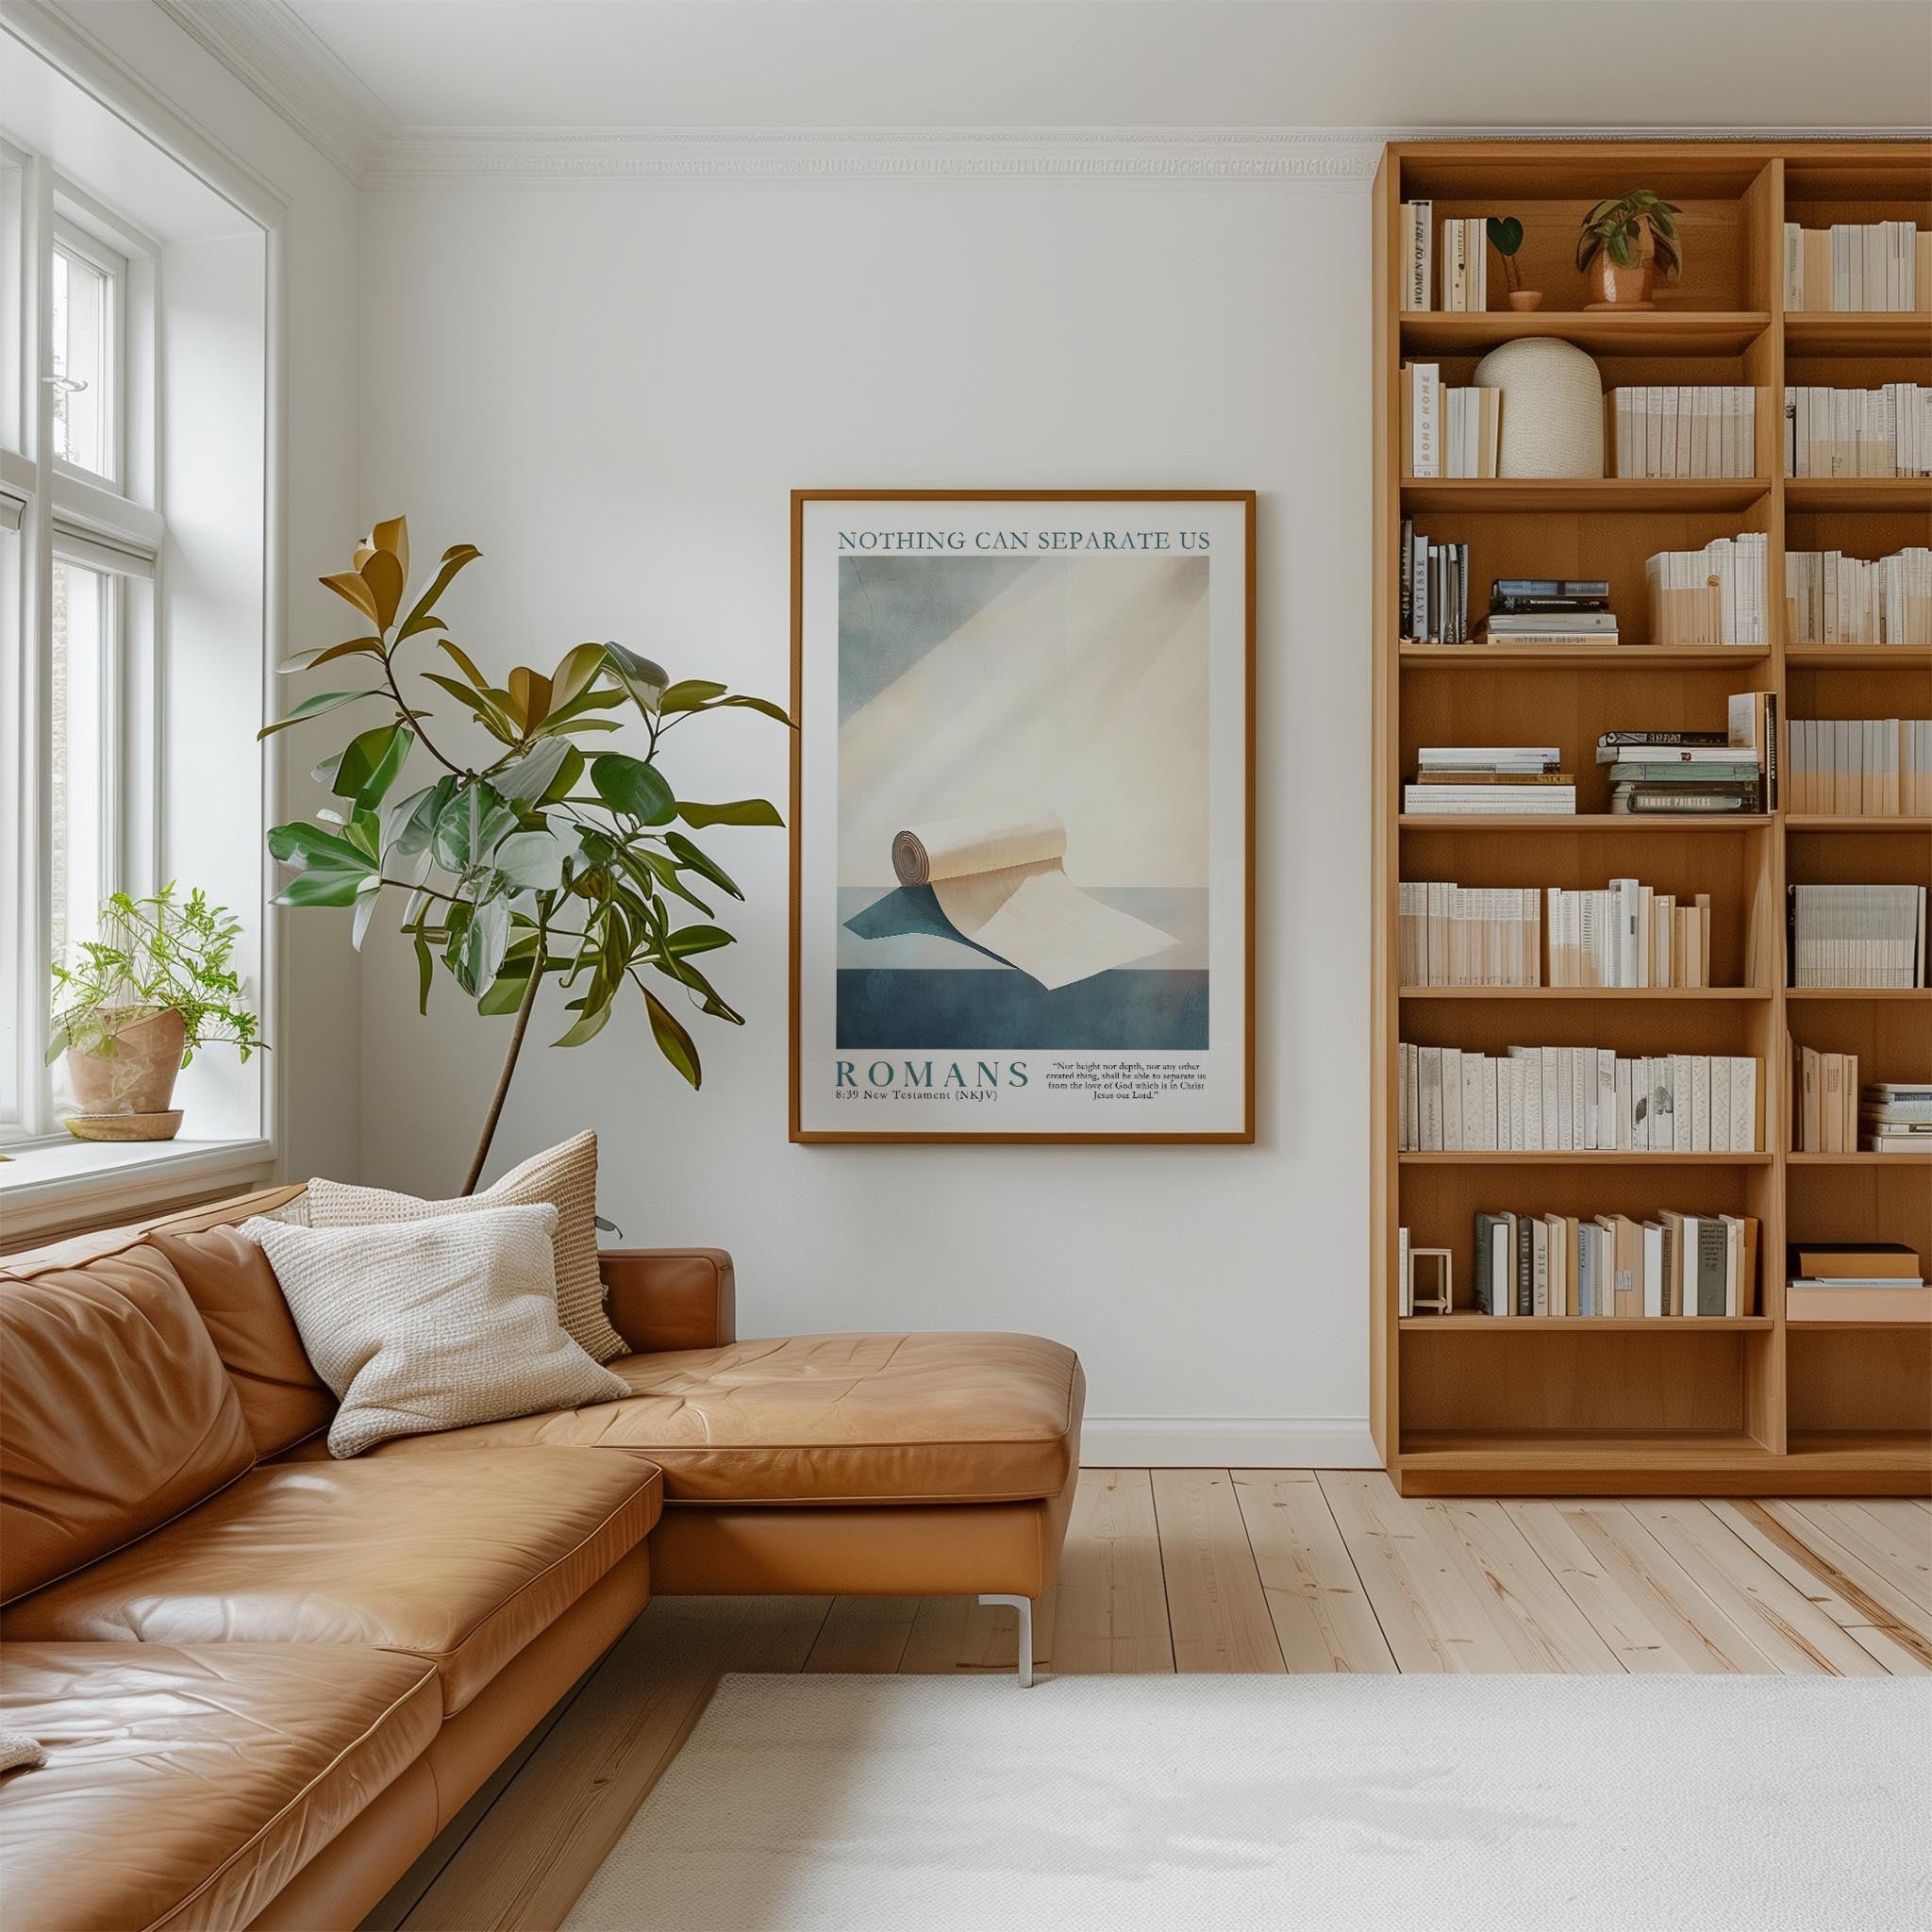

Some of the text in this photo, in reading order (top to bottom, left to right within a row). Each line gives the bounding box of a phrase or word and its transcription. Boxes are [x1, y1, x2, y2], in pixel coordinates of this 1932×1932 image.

[1415, 246, 1424, 260] OF
[1414, 264, 1424, 306] WOMEN
[1422, 375, 1430, 415] HOME
[1422, 422, 1430, 461] BOHO
[838, 531, 1210, 550] NOTHING CAN SEPARATE US
[1416, 559, 1425, 624] MATISSE
[1640, 797, 1711, 808] FAMOUS PAINTERS
[835, 1060, 1029, 1088] ROMANS
[1076, 1062, 1101, 1072] height
[1119, 1062, 1144, 1073] depth,
[1162, 1064, 1176, 1073] any
[1178, 1062, 1200, 1071] other
[1076, 1072, 1100, 1081] thing,
[1163, 1074, 1195, 1082] separate
[1048, 1081, 1068, 1090] from
[1070, 1081, 1083, 1090] the
[1085, 1081, 1102, 1090] love
[1115, 1081, 1133, 1090] God
[1135, 1081, 1159, 1090] which
[1161, 1081, 1168, 1090] is
[1170, 1081, 1178, 1090] in
[1180, 1081, 1205, 1090] Christ
[835, 1090, 998, 1103] 8:39 New Testament (NKJV)
[1092, 1091, 1114, 1101] Jesus
[1538, 1245, 1546, 1305] IVY BIEL
